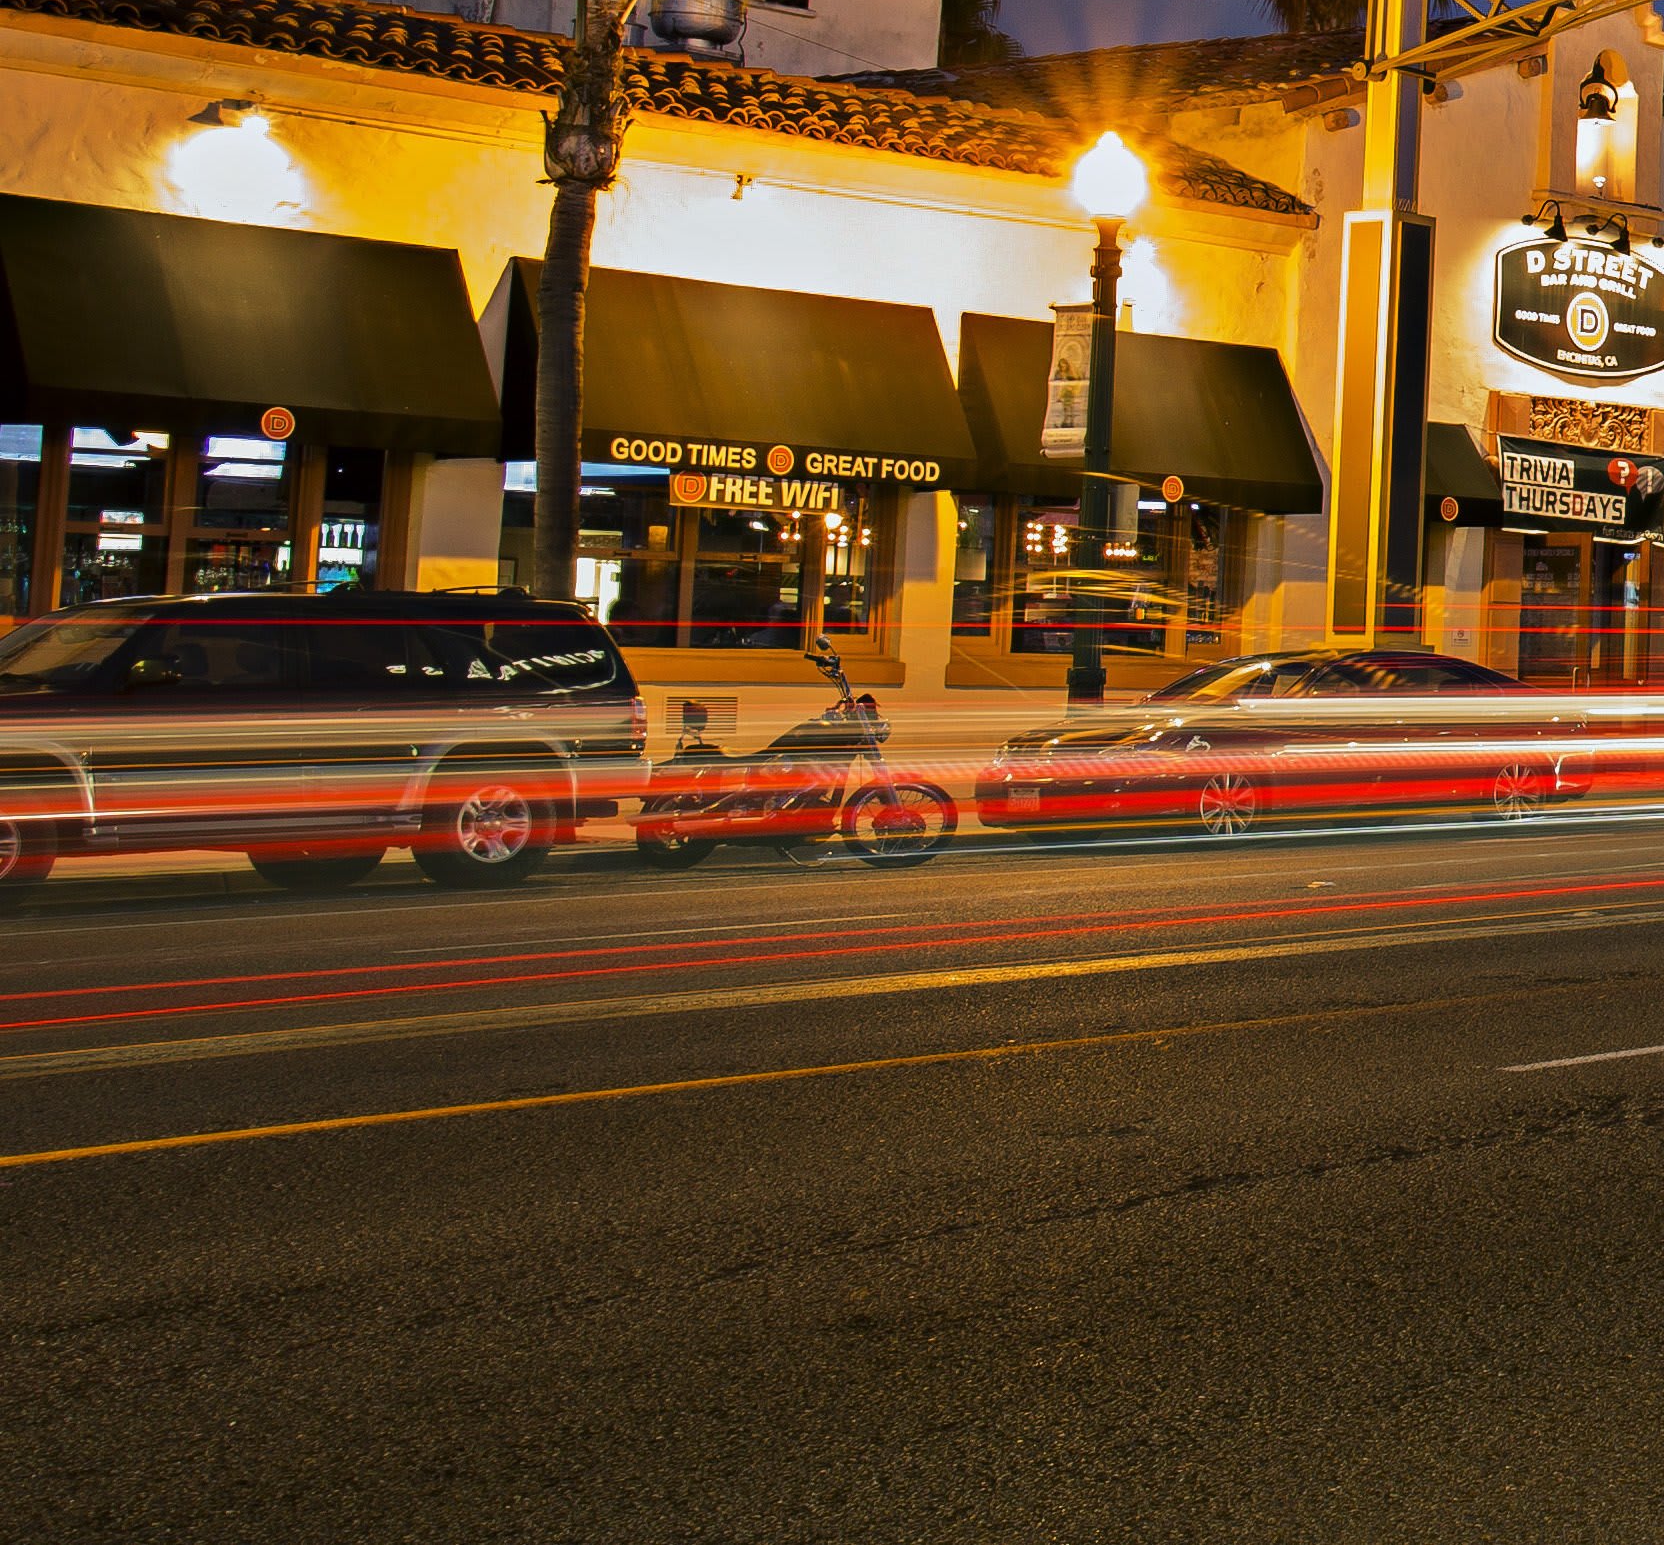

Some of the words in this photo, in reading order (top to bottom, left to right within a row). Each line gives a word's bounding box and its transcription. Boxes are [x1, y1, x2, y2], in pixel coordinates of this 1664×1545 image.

[1526, 250, 1546, 274] D
[1553, 244, 1654, 289] STREET
[1540, 274, 1567, 287] BAR
[1570, 274, 1598, 288] AND
[1598, 278, 1637, 300] GRILL
[1605, 355, 1618, 366] CA
[269, 414, 289, 431] D
[611, 437, 682, 463] GOOD
[687, 443, 756, 468] TIMES
[805, 453, 877, 477] GREAT
[881, 459, 940, 482] FOOD
[1506, 456, 1571, 486] TRIVIA
[708, 472, 774, 506] FREE
[780, 478, 839, 510] WIFI
[1505, 486, 1624, 521] THURSDAYS
